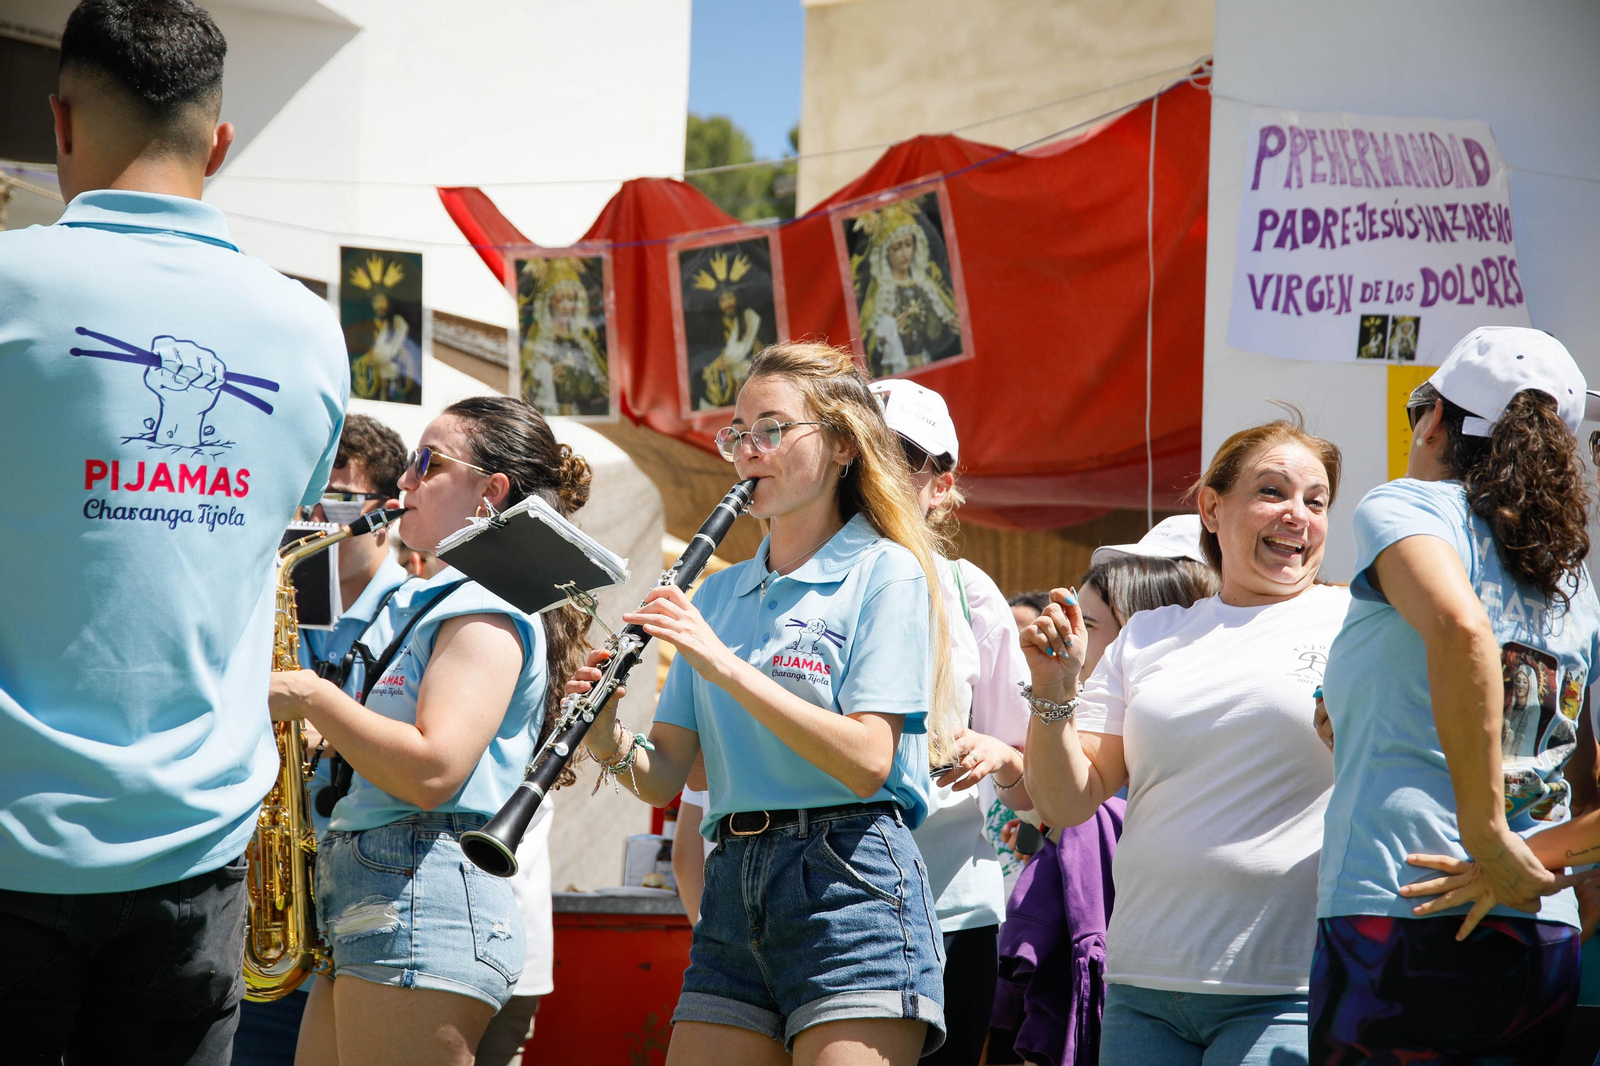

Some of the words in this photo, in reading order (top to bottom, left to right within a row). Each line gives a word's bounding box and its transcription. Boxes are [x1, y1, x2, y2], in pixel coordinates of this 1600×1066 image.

[1251, 124, 1491, 191] PREHERMANDAD
[1247, 272, 1354, 316] VIRGEN
[1360, 281, 1381, 304] DE
[1419, 254, 1524, 308] DOLORES
[84, 459, 251, 498] PIJAMAS
[82, 498, 195, 530] Charanga
[771, 669, 807, 681] Charanga
[772, 655, 831, 676] PIJAMAS
